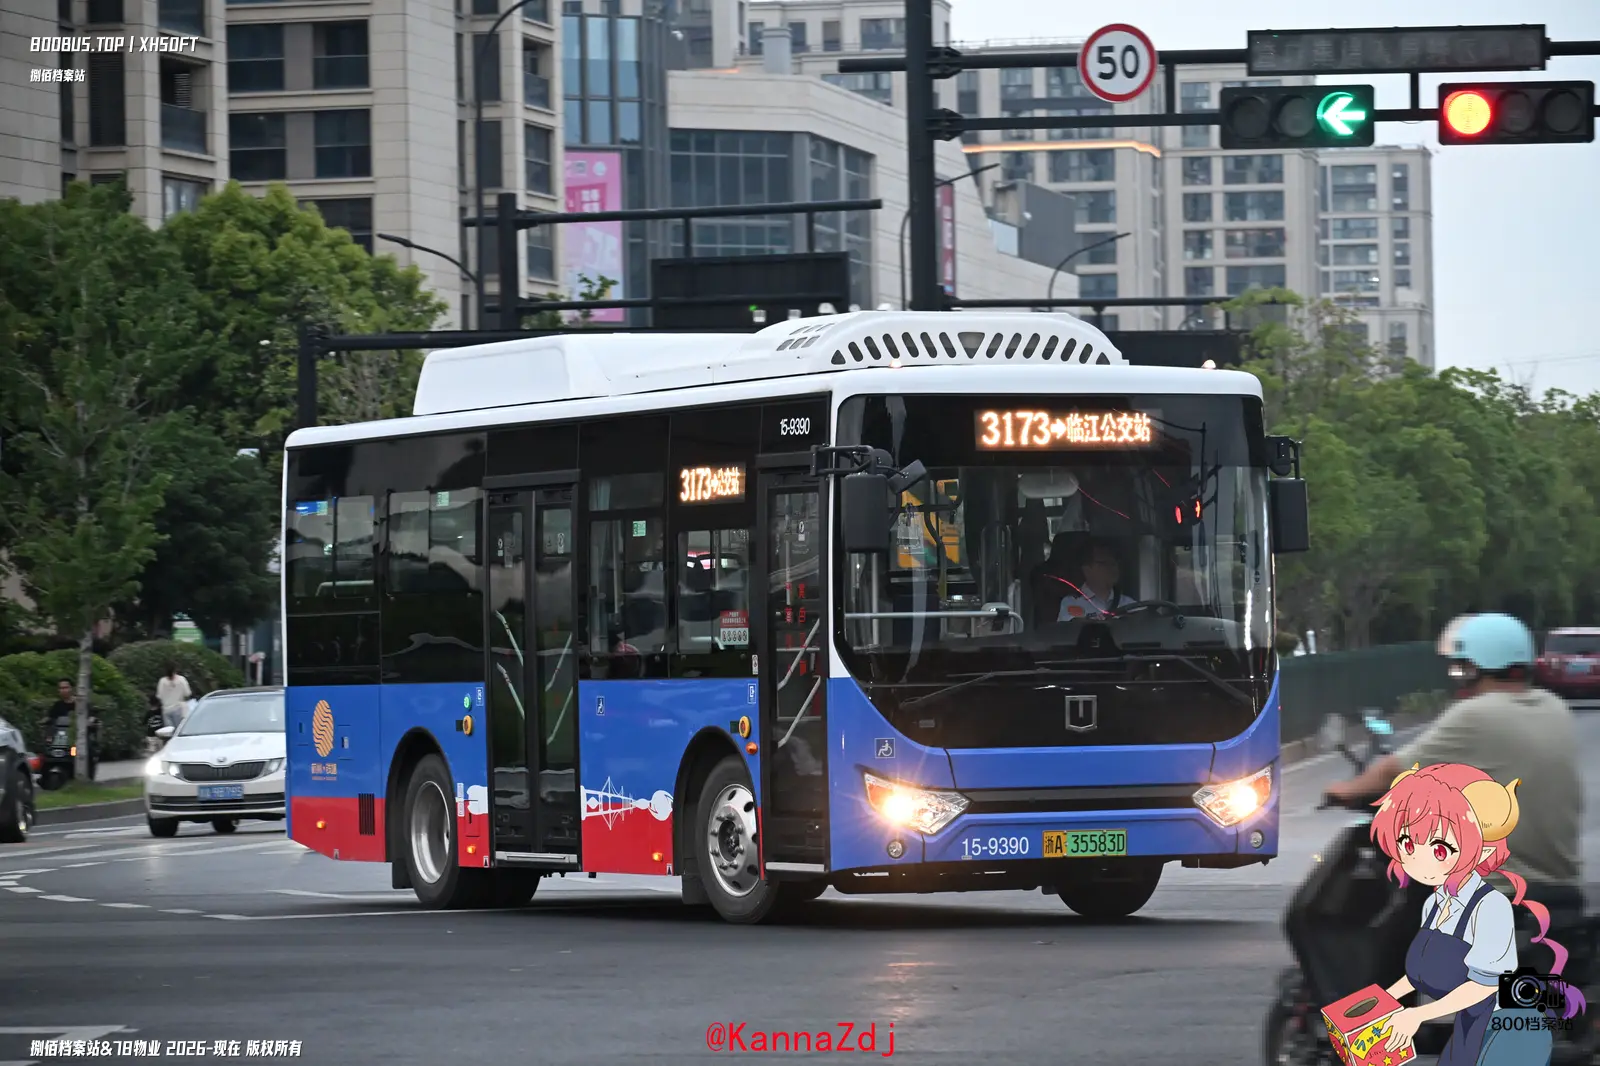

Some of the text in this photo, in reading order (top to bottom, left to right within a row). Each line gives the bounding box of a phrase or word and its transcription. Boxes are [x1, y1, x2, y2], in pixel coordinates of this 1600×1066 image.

[1097, 45, 1139, 80] 50
[780, 418, 810, 435] 15-9390
[982, 411, 1151, 445] 3173 临江公交站
[680, 468, 711, 501] 3173
[962, 837, 1029, 856] 15-9390
[1071, 834, 1125, 853] 35583D
